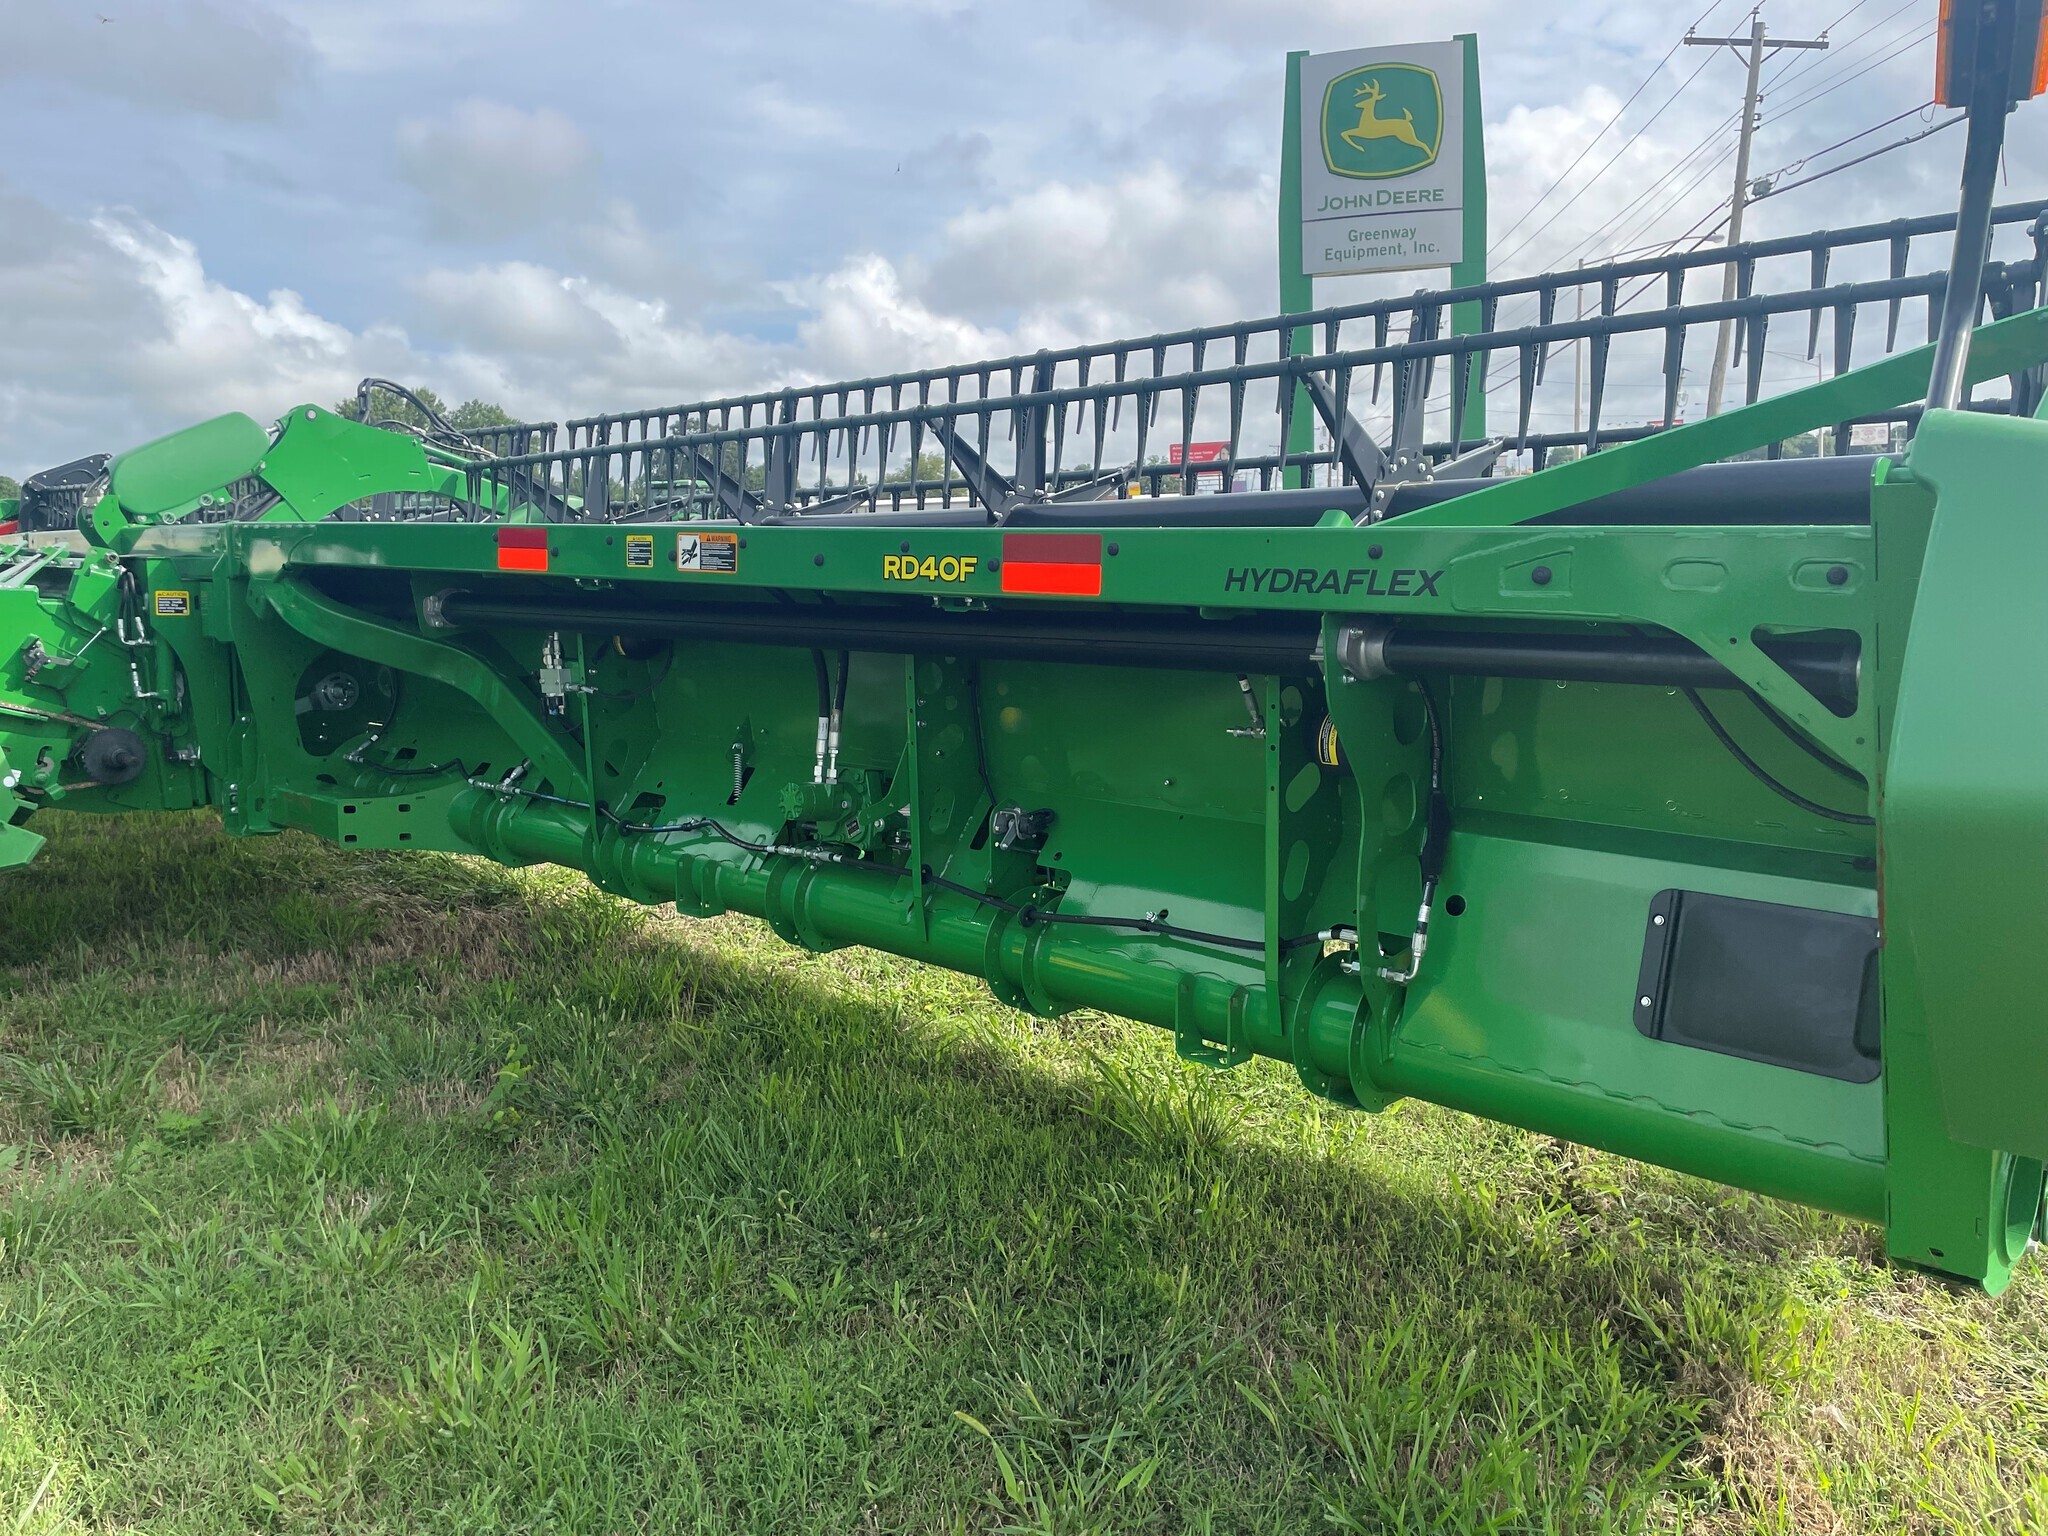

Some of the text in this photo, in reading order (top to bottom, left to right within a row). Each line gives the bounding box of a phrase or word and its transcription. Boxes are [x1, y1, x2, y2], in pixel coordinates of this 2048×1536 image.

[1317, 188, 1445, 212] JOHN DEERE
[1348, 227, 1417, 242] Greenway
[1324, 241, 1440, 262] Equipment, Inc.
[883, 555, 978, 582] RD40F
[1224, 567, 1445, 597] HYDRAFLEX
